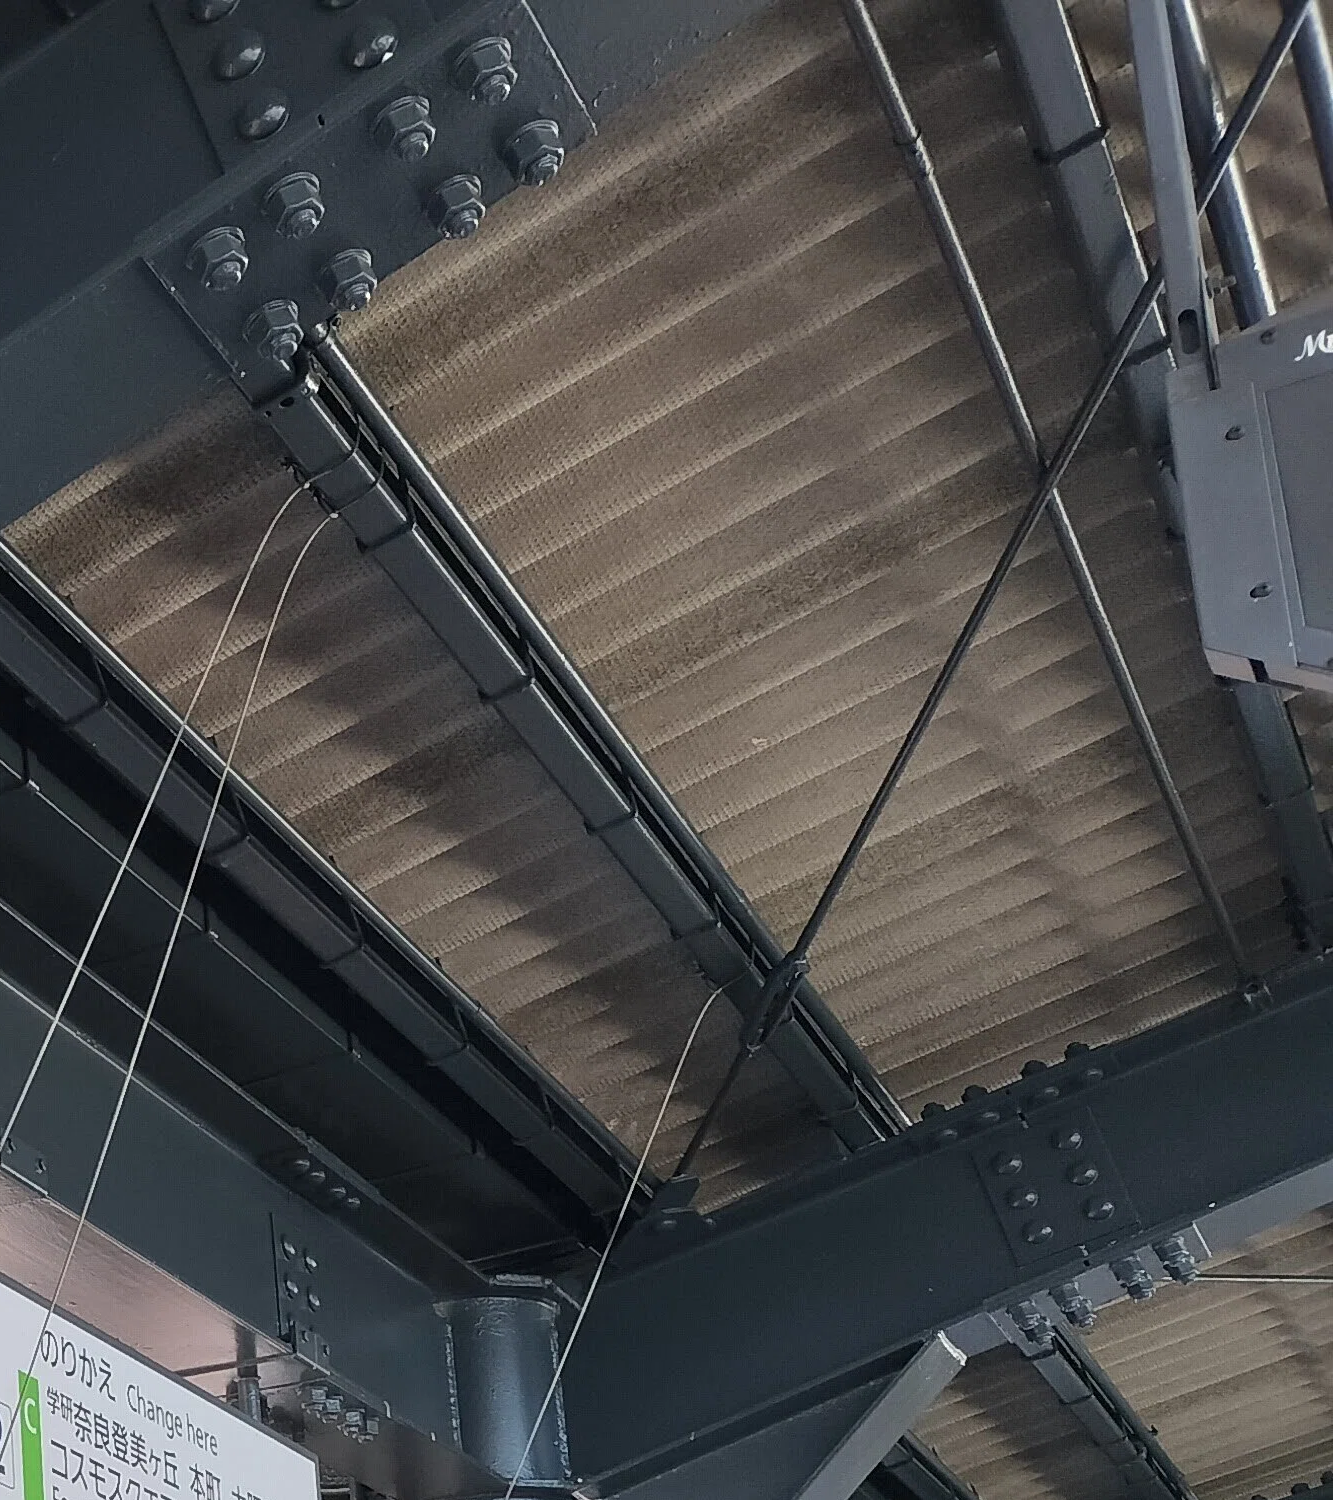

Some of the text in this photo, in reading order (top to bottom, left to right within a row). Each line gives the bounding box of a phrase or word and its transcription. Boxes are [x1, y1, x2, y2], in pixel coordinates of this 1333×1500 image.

[24, 1398, 37, 1434] C
[41, 1330, 218, 1456] のりかえ Change here
